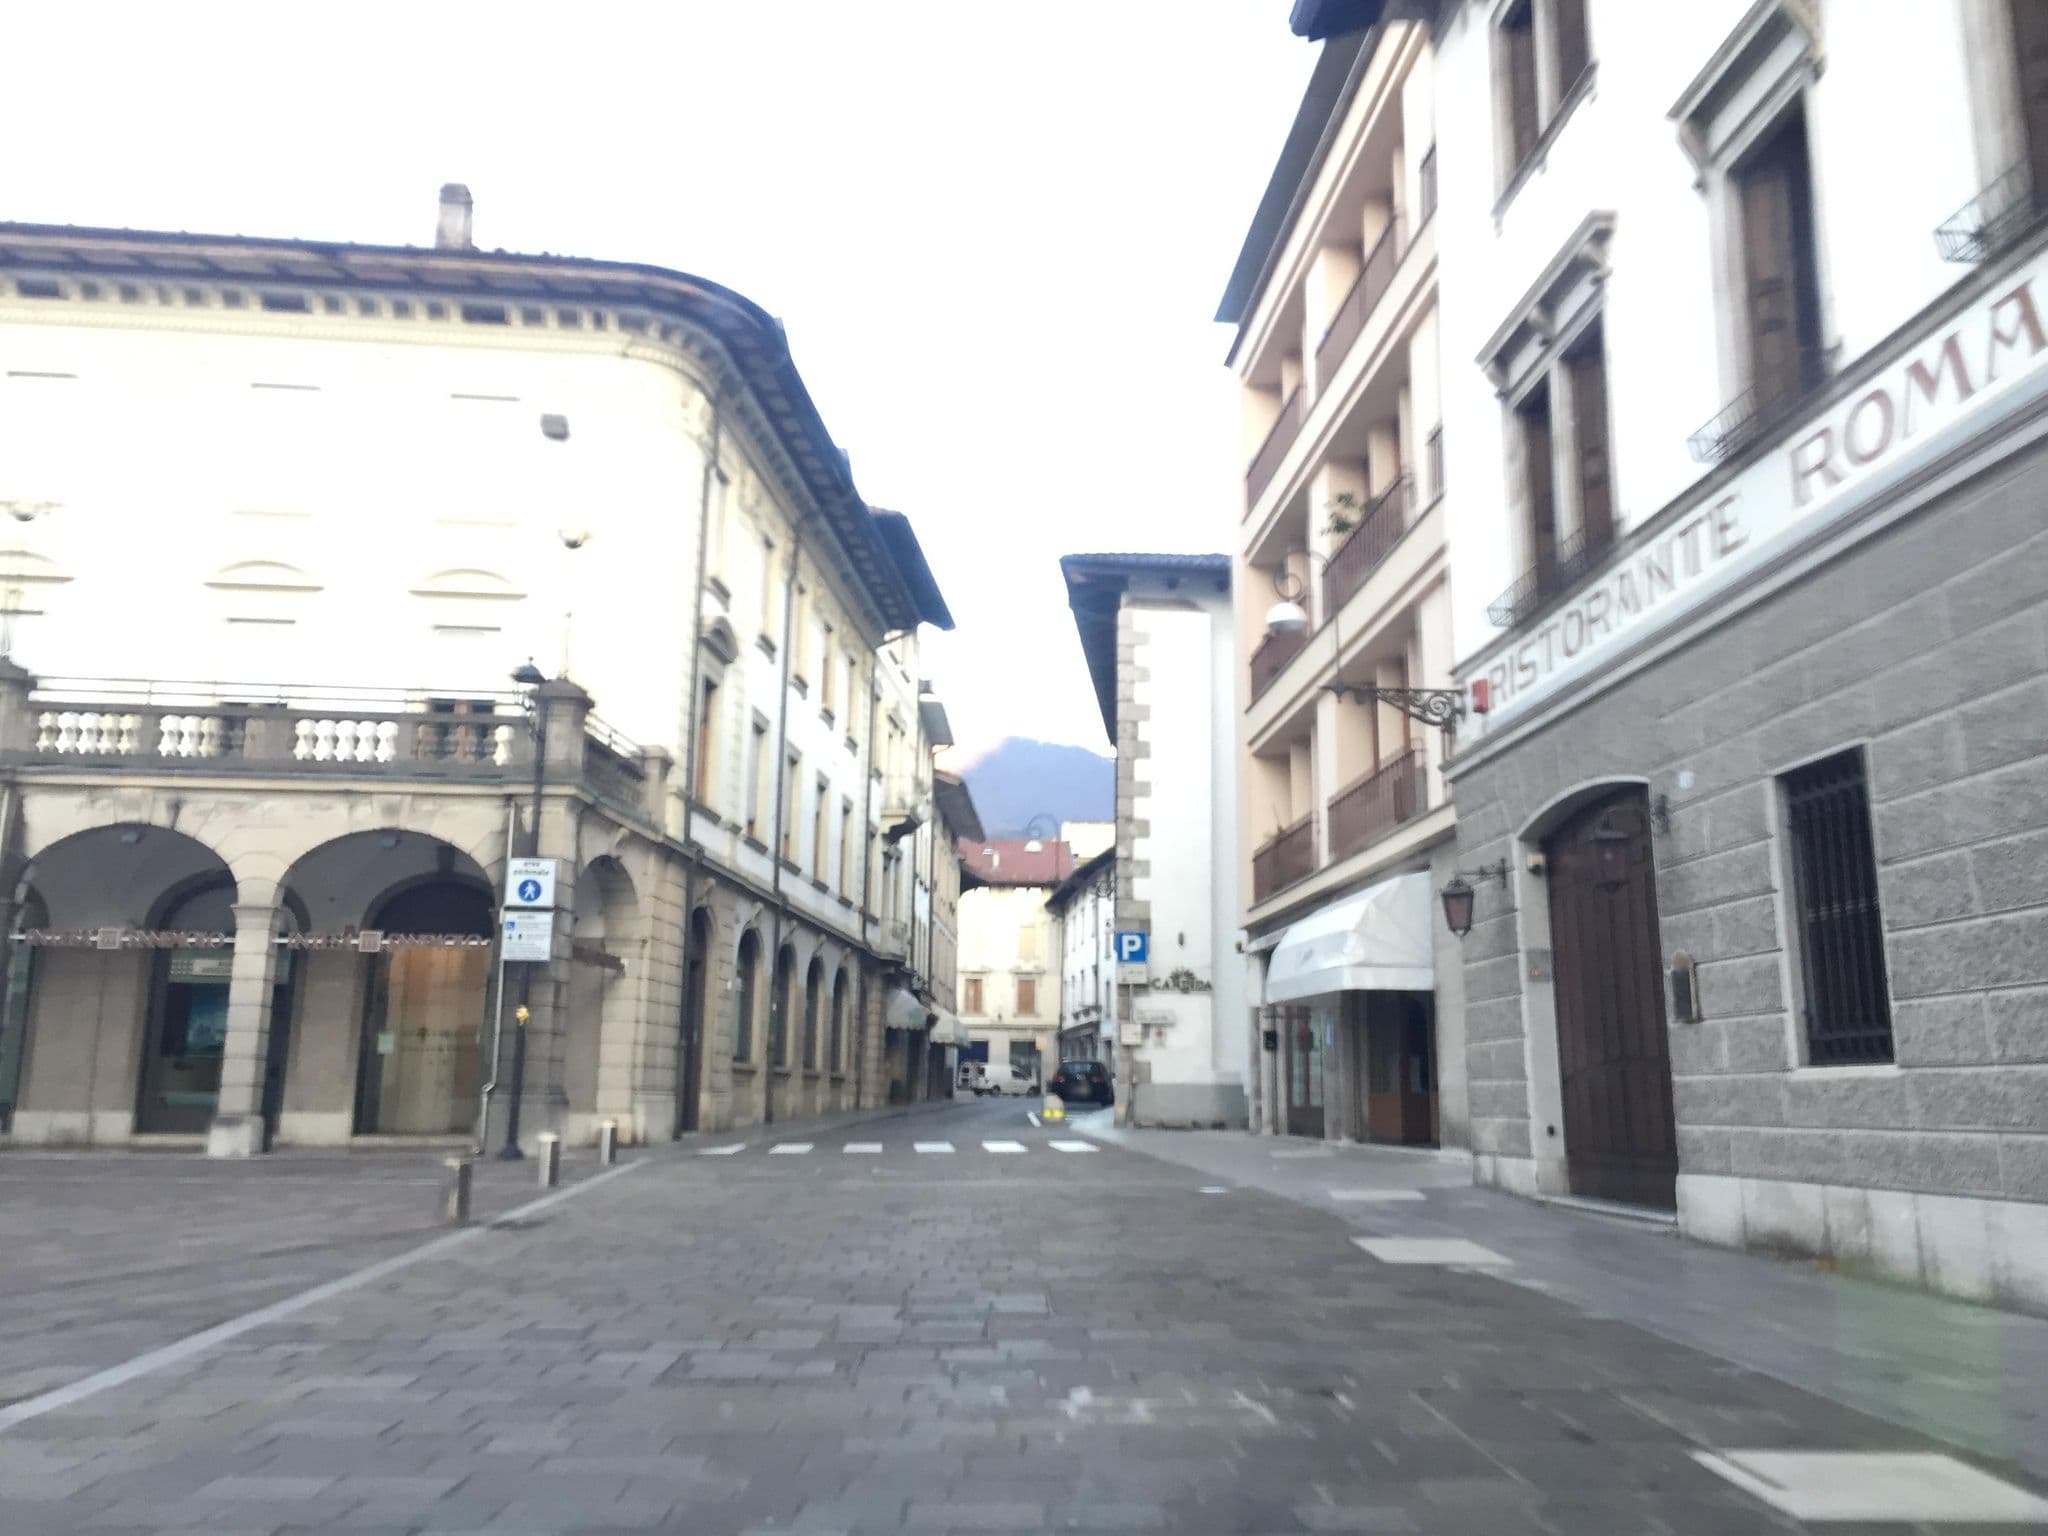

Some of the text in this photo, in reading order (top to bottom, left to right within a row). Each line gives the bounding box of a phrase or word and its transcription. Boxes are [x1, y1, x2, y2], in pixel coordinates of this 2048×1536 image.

[1488, 275, 2048, 709] RISTORANTE ROMA
[1121, 935, 1142, 960] P
